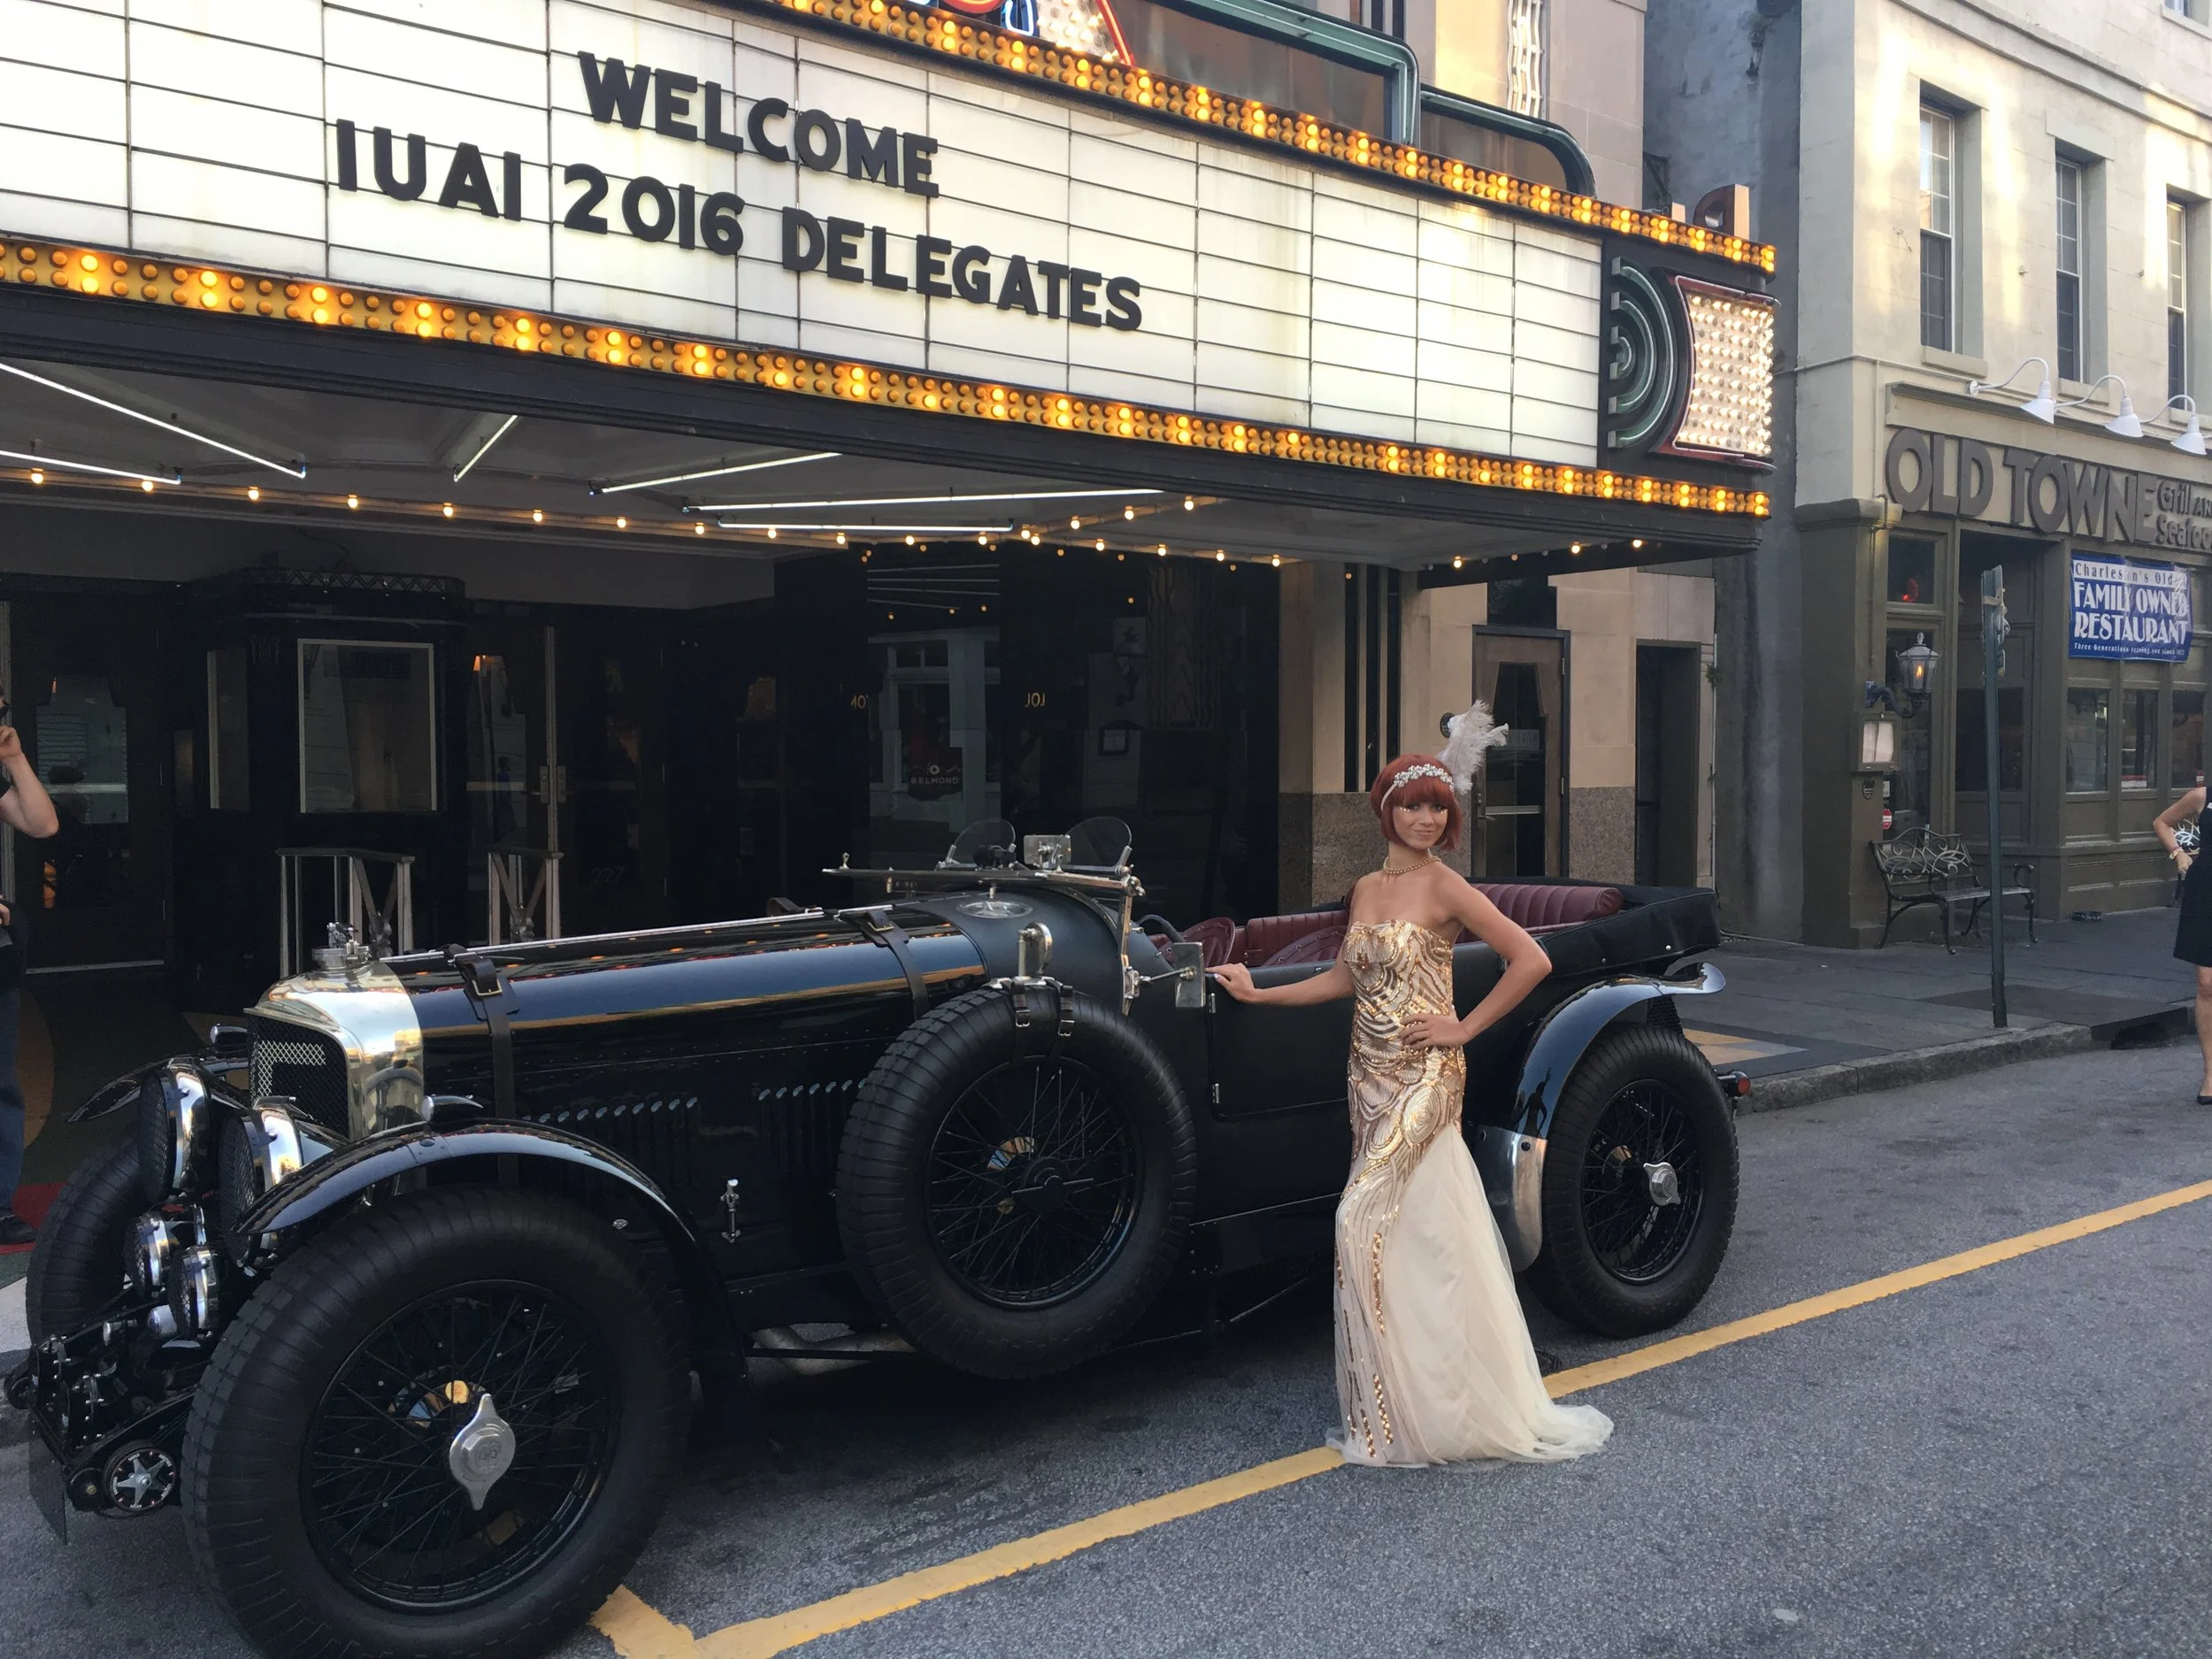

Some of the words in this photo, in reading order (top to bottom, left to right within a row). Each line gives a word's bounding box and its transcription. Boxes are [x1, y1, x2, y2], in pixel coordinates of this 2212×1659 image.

[577, 51, 940, 198] WELCOME
[335, 119, 521, 221] IUAI
[564, 164, 745, 257] 2016
[782, 206, 1142, 332] DELEGATES
[1886, 427, 1993, 517] OLD
[2003, 446, 2157, 544] TOWNE
[2156, 480, 2192, 515] Grill
[2193, 497, 2212, 518] AN
[2155, 514, 2212, 549] Seafoo
[2075, 563, 2149, 583] Charlesn's
[2073, 580, 2131, 612] FAMILY
[2136, 588, 2189, 617] OWNED
[2073, 611, 2189, 644] RESTAURANT
[2074, 641, 2091, 650] Three
